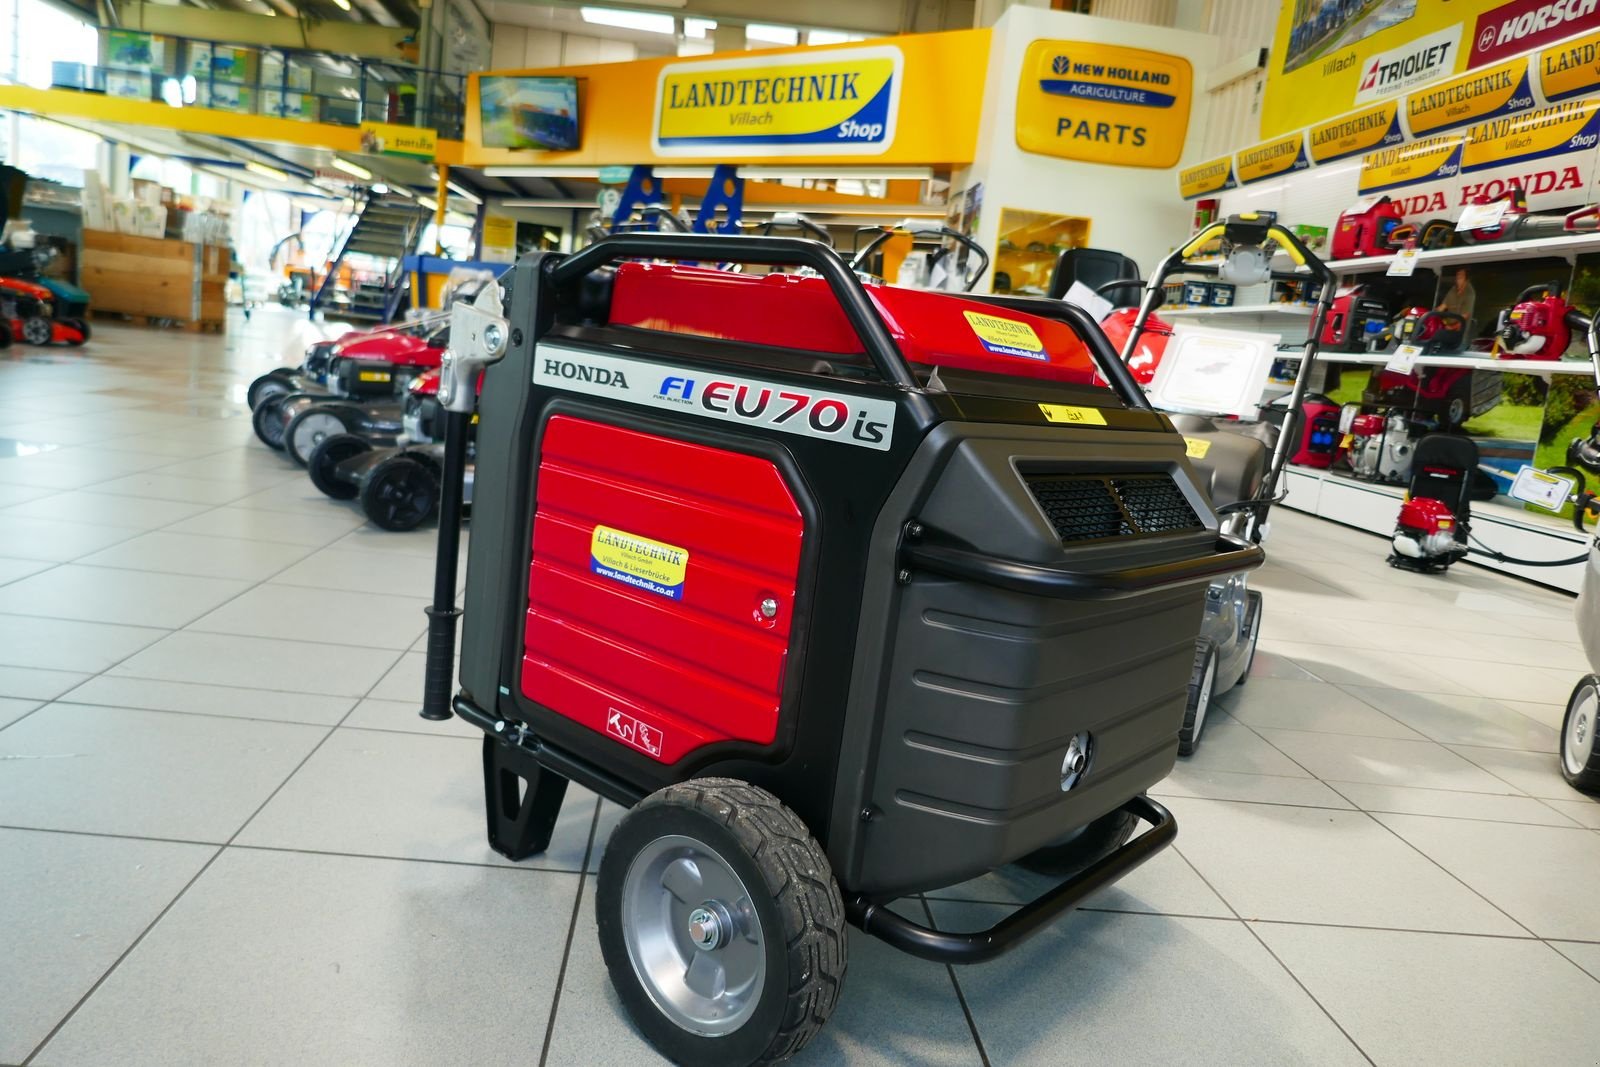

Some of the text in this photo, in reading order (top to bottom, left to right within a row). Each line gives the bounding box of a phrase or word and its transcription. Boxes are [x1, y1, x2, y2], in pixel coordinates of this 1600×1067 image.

[1496, 0, 1598, 46] HORSCH
[1073, 62, 1171, 85] NEW HOLLAND
[1323, 51, 1357, 77] Villach
[669, 72, 860, 110] LANDTECHNIK
[1069, 84, 1146, 103] AGRICULTURE
[1411, 69, 1513, 116] LANDTECHNIK
[1508, 96, 1532, 110] Shop
[729, 111, 774, 126] Villach
[837, 120, 883, 141] Shop
[1056, 117, 1148, 147] PARTS
[1312, 110, 1387, 146] LANDTECHNIK
[1470, 100, 1586, 146] LANDTECHNIK
[1238, 140, 1296, 169] LANDTECHNIK
[1364, 136, 1450, 171] LANDTECHNIK
[1505, 136, 1532, 151] Villach
[1569, 133, 1597, 149] Shop
[1437, 164, 1459, 177] Shop
[1458, 166, 1583, 206] HONDA
[543, 359, 630, 389] HONDA
[659, 376, 696, 400] FI
[667, 396, 694, 406] INJECTION
[597, 529, 683, 566] LANDTECHNIK
[596, 567, 675, 597] www.landtechnik.co.at
[602, 555, 623, 567] Villach
[629, 564, 671, 583] Lieserbrücke
